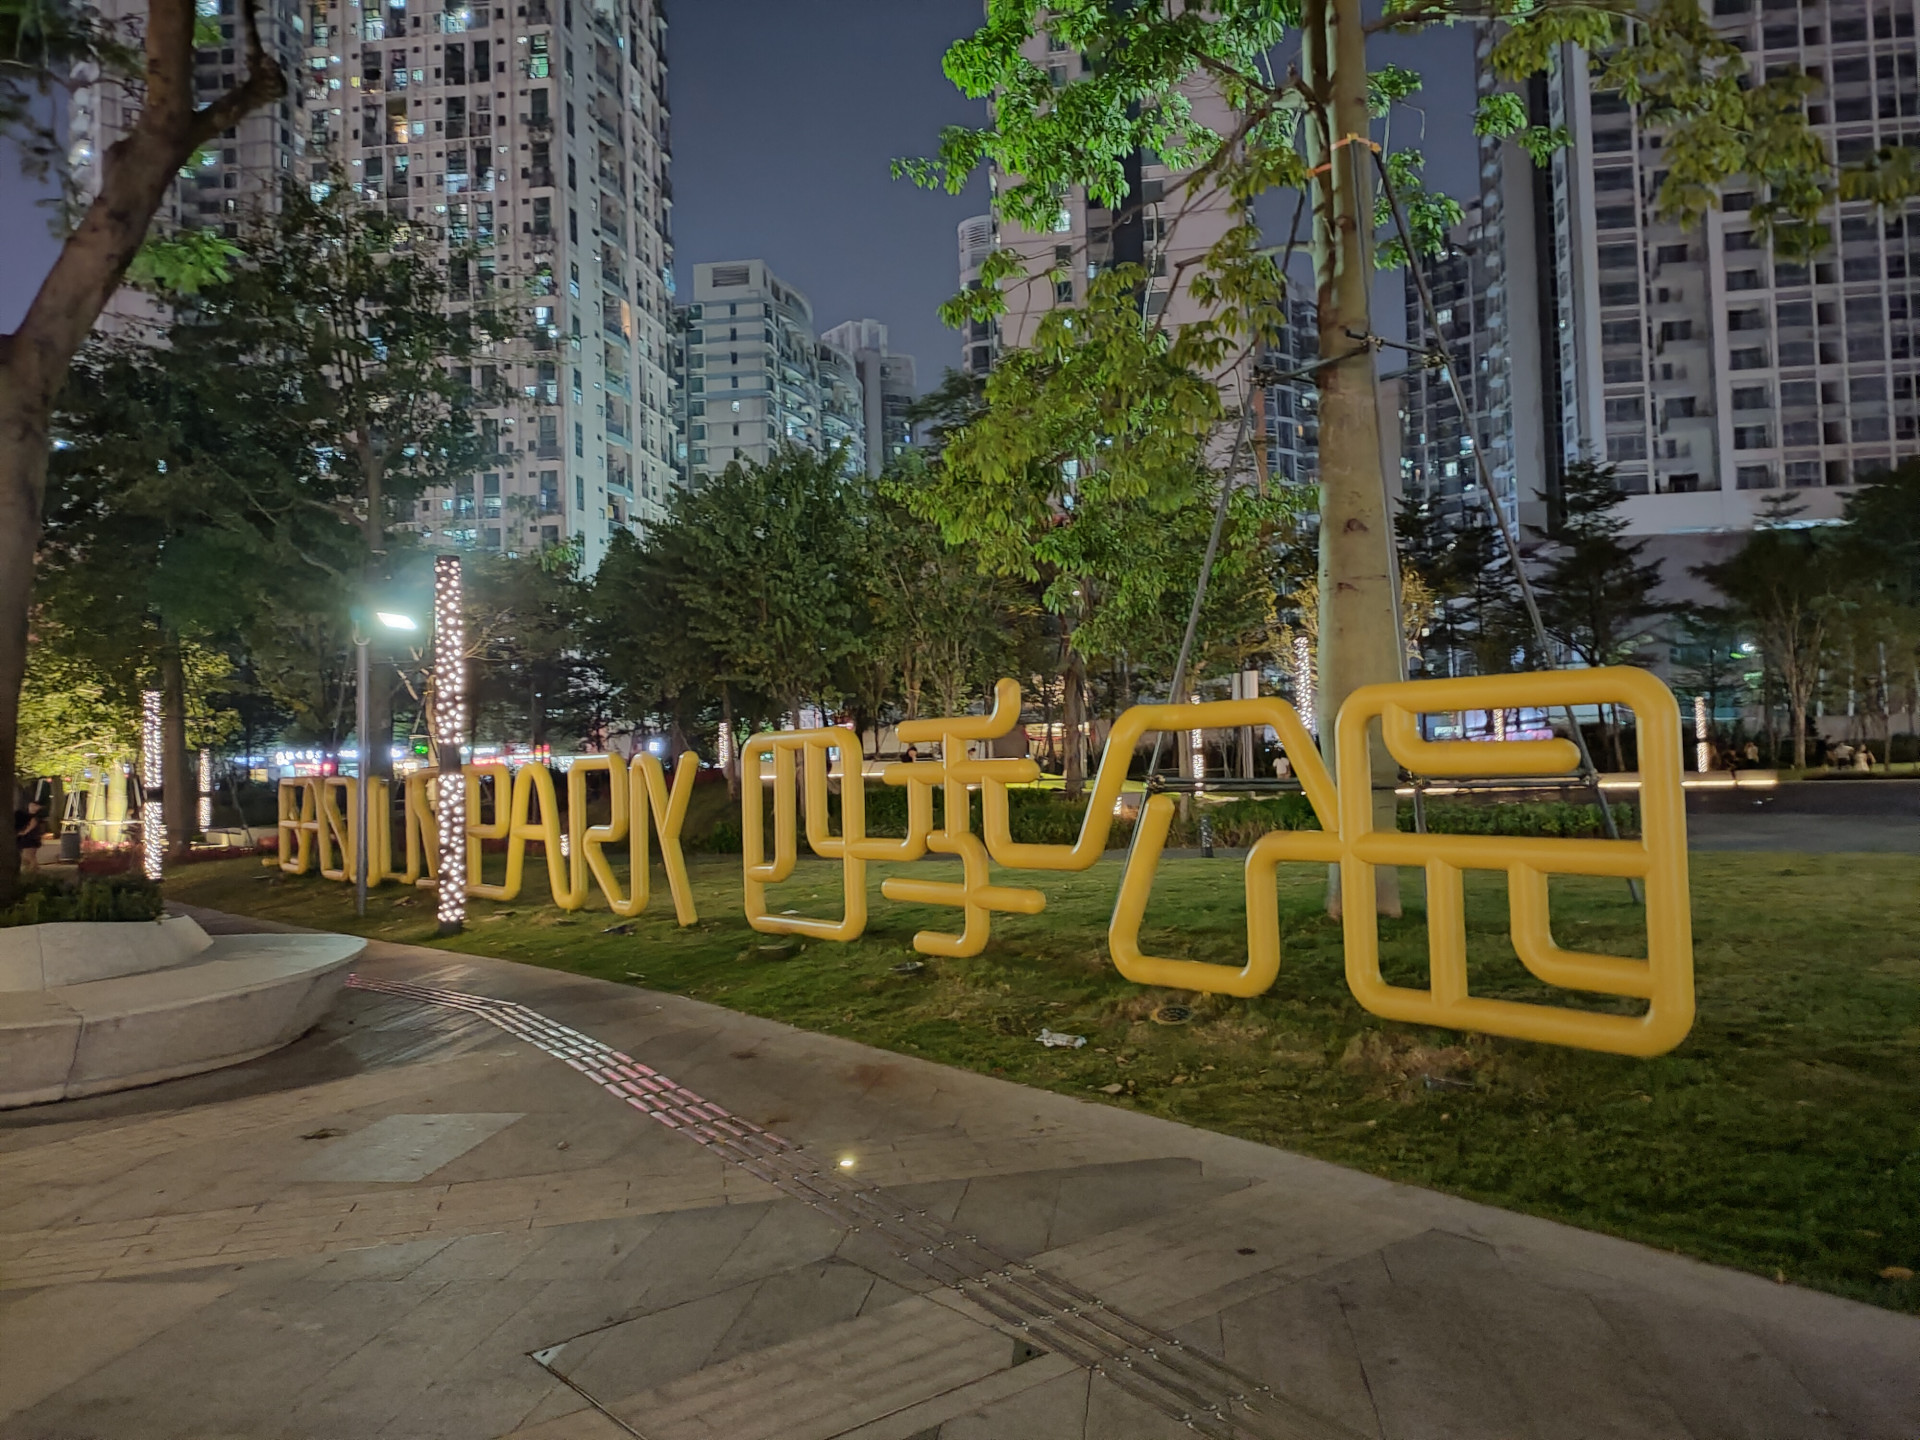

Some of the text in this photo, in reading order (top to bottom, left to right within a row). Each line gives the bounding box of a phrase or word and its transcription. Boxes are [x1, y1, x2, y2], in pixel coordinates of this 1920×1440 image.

[464, 751, 699, 928] PARK
[742, 667, 1696, 1058] 四季公园
